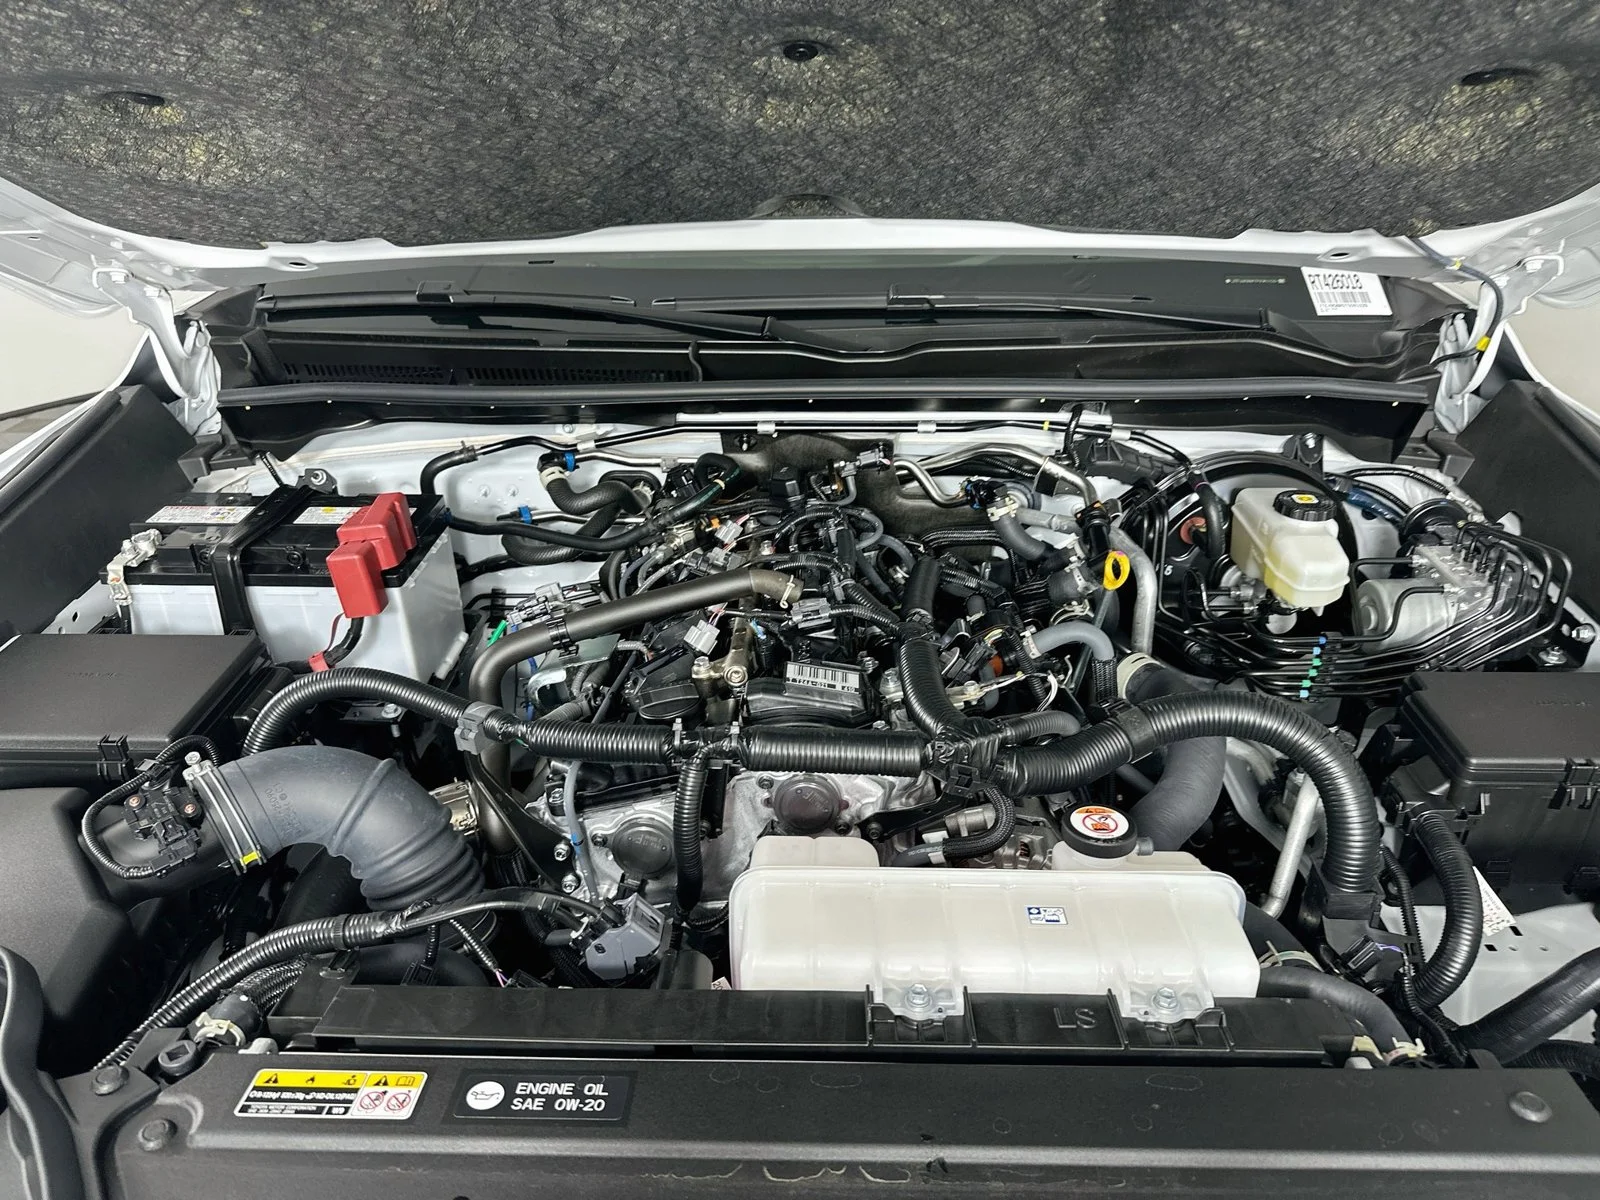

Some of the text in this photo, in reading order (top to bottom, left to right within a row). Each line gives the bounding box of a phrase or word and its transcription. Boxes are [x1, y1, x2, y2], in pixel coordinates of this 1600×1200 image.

[1053, 1007, 1098, 1029] LS
[515, 1082, 609, 1096] ENGINE OIL
[510, 1097, 606, 1112] SAE 0W-20
